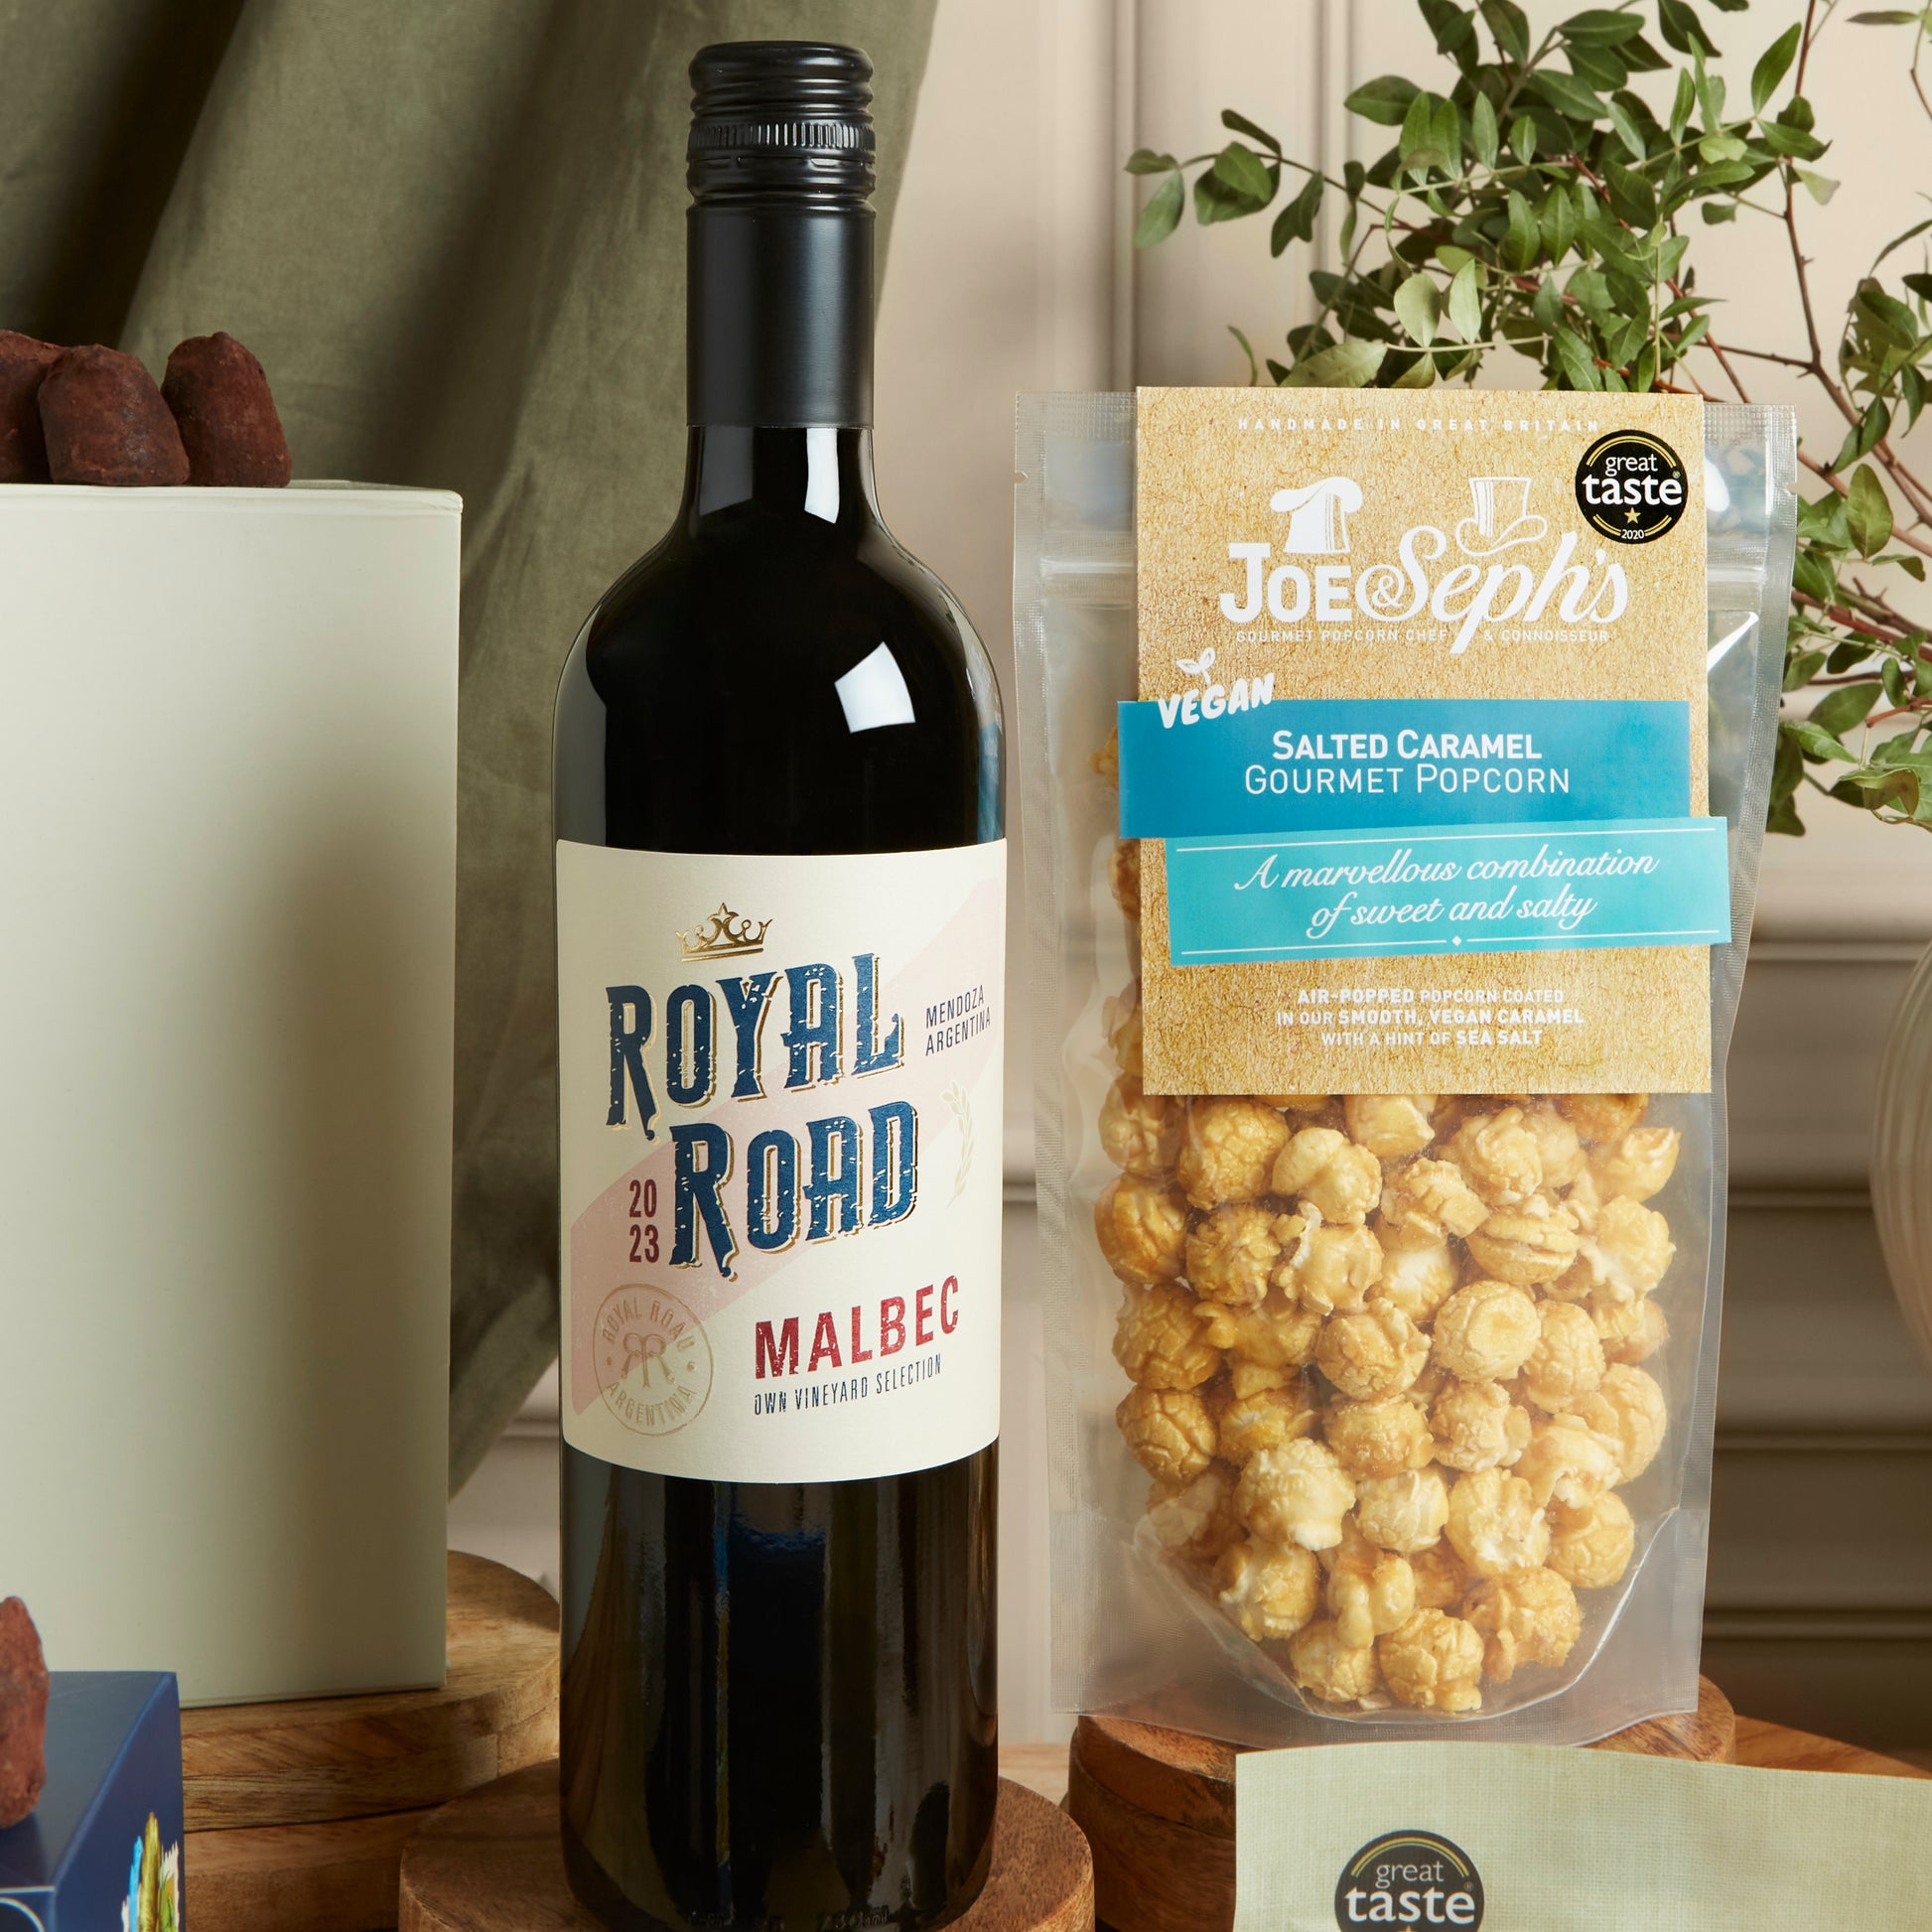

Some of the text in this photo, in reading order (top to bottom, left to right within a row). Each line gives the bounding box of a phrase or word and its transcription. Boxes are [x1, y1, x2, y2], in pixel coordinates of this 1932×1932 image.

[1239, 418, 1597, 432] HANDMADE IN GREAT BRITAIN
[1604, 454, 1658, 477] great
[1582, 474, 1683, 505] taste
[1621, 529, 1644, 540] 2020
[1219, 525, 1628, 654] JOE & Seph's
[1237, 629, 1609, 642] GOURMET POPCORN CHEF & CONNOISSEUR
[1157, 673, 1275, 729] VEGAN
[1272, 730, 1542, 759] SALTED CARAMEL
[1245, 763, 1569, 795] GOURMET POPCORN
[1234, 844, 1660, 891] A marvellous combination
[1306, 883, 1597, 939] of sweet and salty
[926, 984, 985, 1029] MENDOZA
[1297, 989, 1565, 1005] AIR-POPPED POPCORN COATED
[926, 1007, 991, 1056] ARGENTINA
[1277, 1009, 1585, 1027] IN OUR SMOOTH, VEGAN CARAMEL
[606, 953, 904, 1144] ROYAL
[1321, 1030, 1543, 1046] WITH A HINT OF SEA SALT
[628, 1179, 657, 1218] 20
[669, 1101, 918, 1282] ROAD
[628, 1223, 659, 1263] 23
[602, 1297, 695, 1352] ROYAL ROAD
[755, 1275, 959, 1379] MALBEC
[754, 1353, 941, 1415] OWN VINEYARD SELECTION
[607, 1382, 697, 1426] ARGENTINA
[1375, 1860, 1445, 1889] great
[1344, 1886, 1475, 1924] taste
